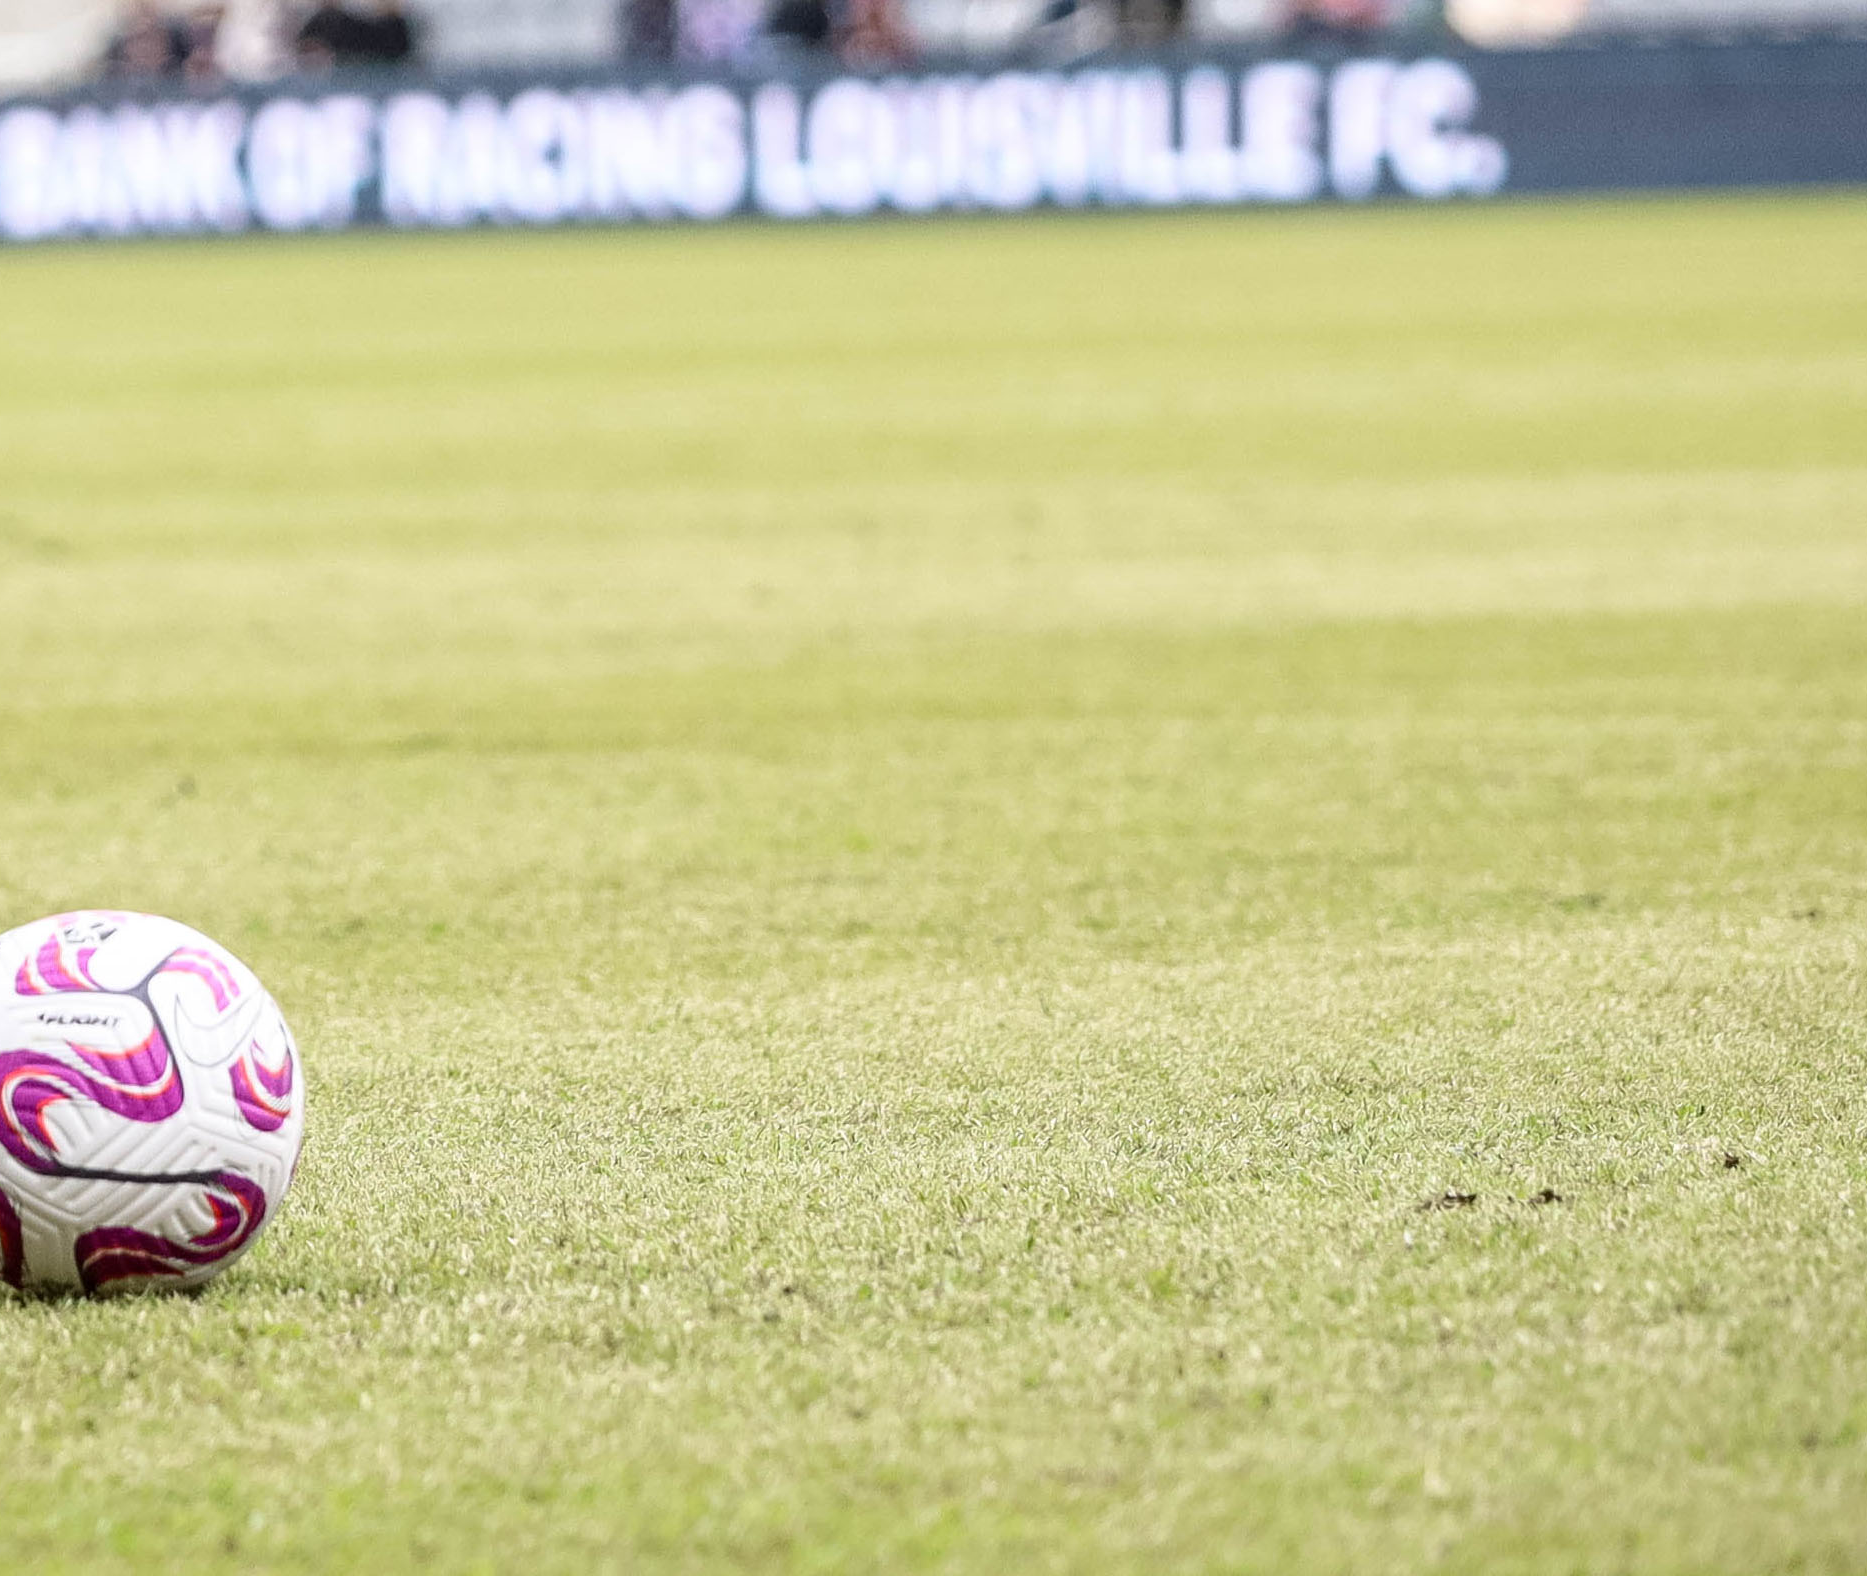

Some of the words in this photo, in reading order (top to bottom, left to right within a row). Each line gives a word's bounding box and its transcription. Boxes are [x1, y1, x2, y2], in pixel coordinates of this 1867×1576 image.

[248, 97, 373, 226] OF
[381, 86, 746, 220] RACING
[753, 64, 1319, 213] LOUISVILLE
